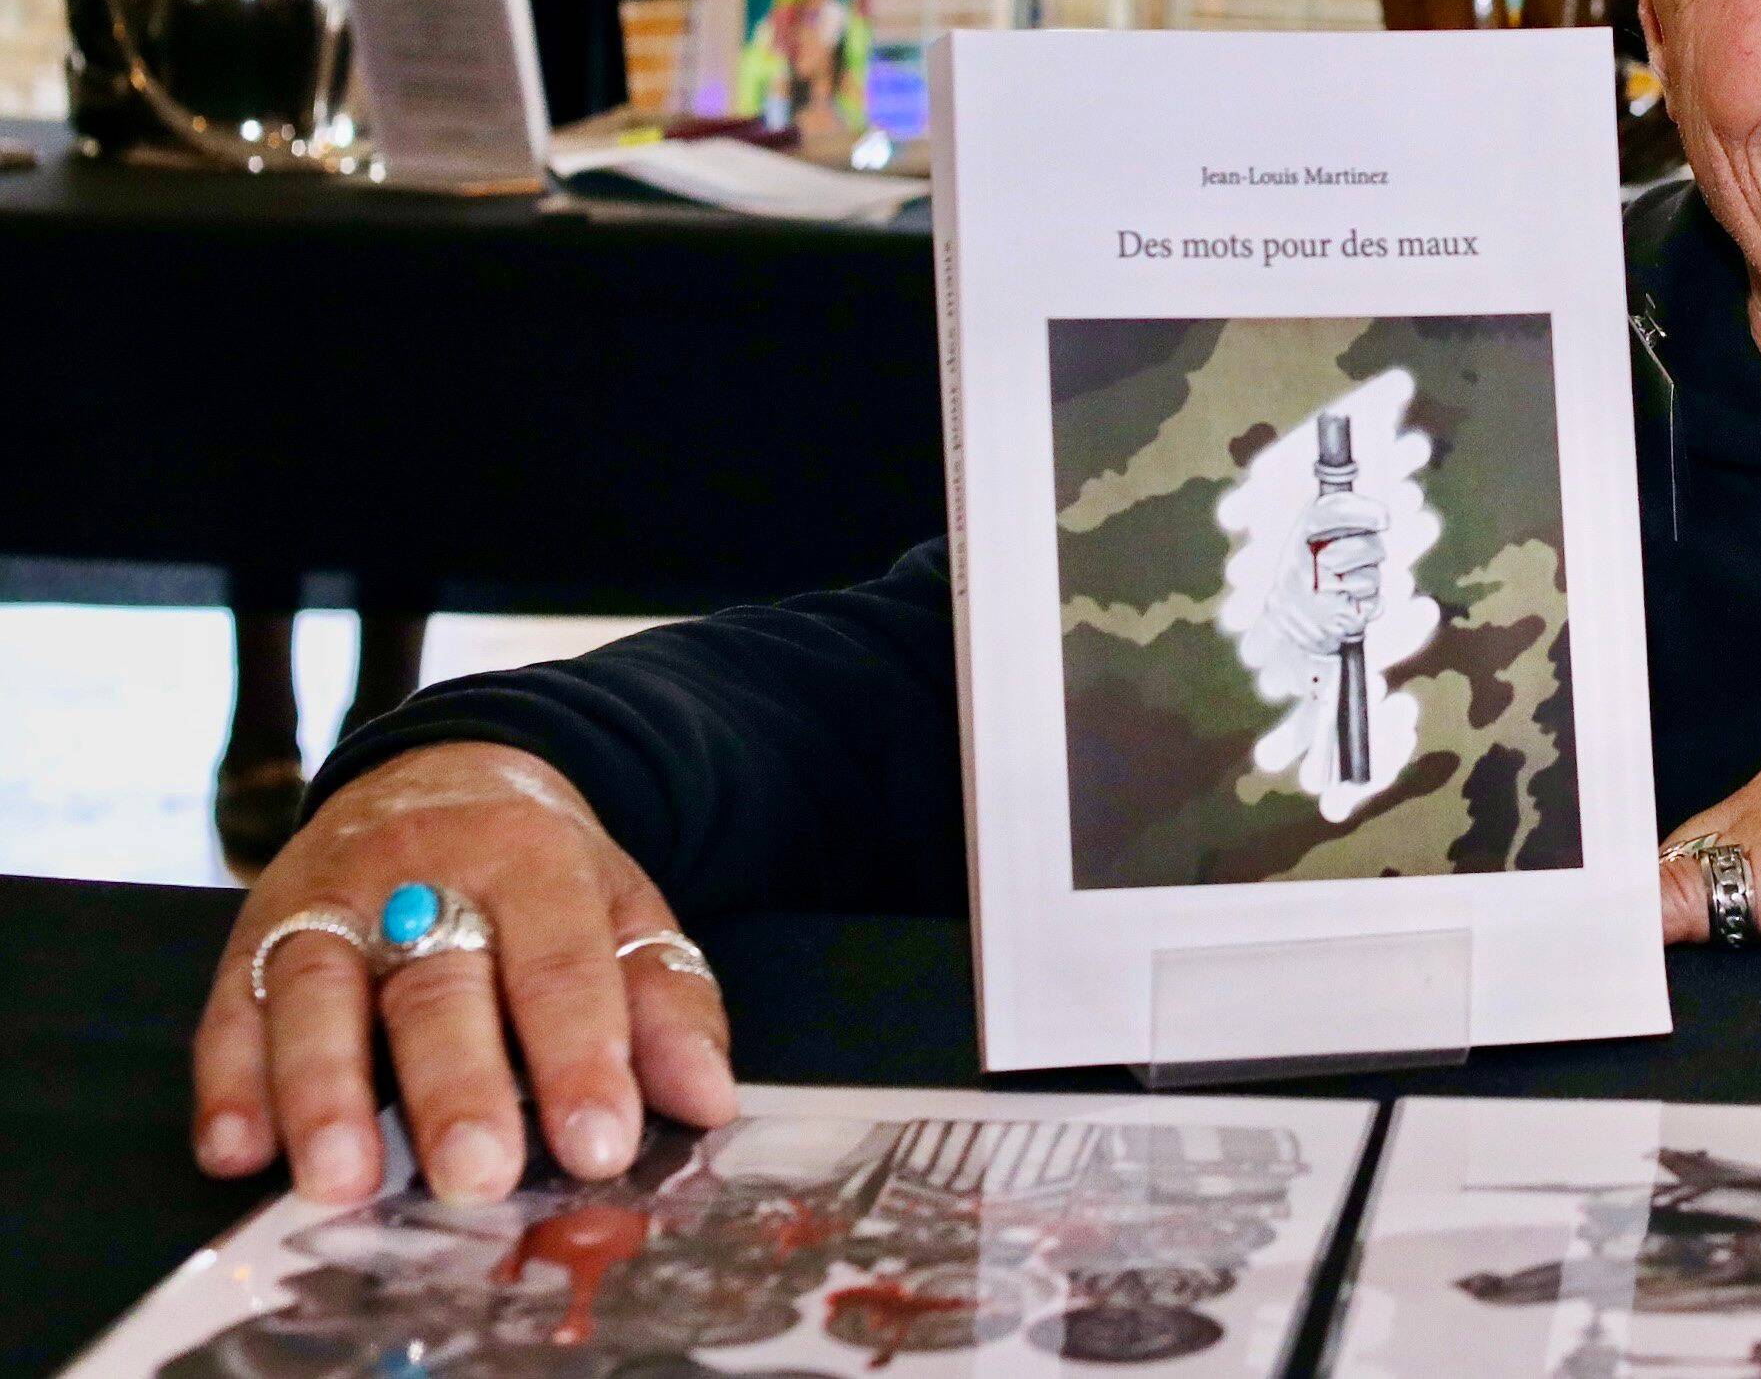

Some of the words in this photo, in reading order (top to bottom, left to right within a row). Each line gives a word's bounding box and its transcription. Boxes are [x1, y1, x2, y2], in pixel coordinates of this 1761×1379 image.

[1202, 166, 1301, 188] Jean-Louis
[1304, 167, 1390, 187] Martinez
[1117, 230, 1174, 260] Des
[1182, 235, 1256, 260] mots
[1263, 238, 1334, 268] pour
[1341, 228, 1390, 260] des
[1398, 237, 1481, 259] maux
